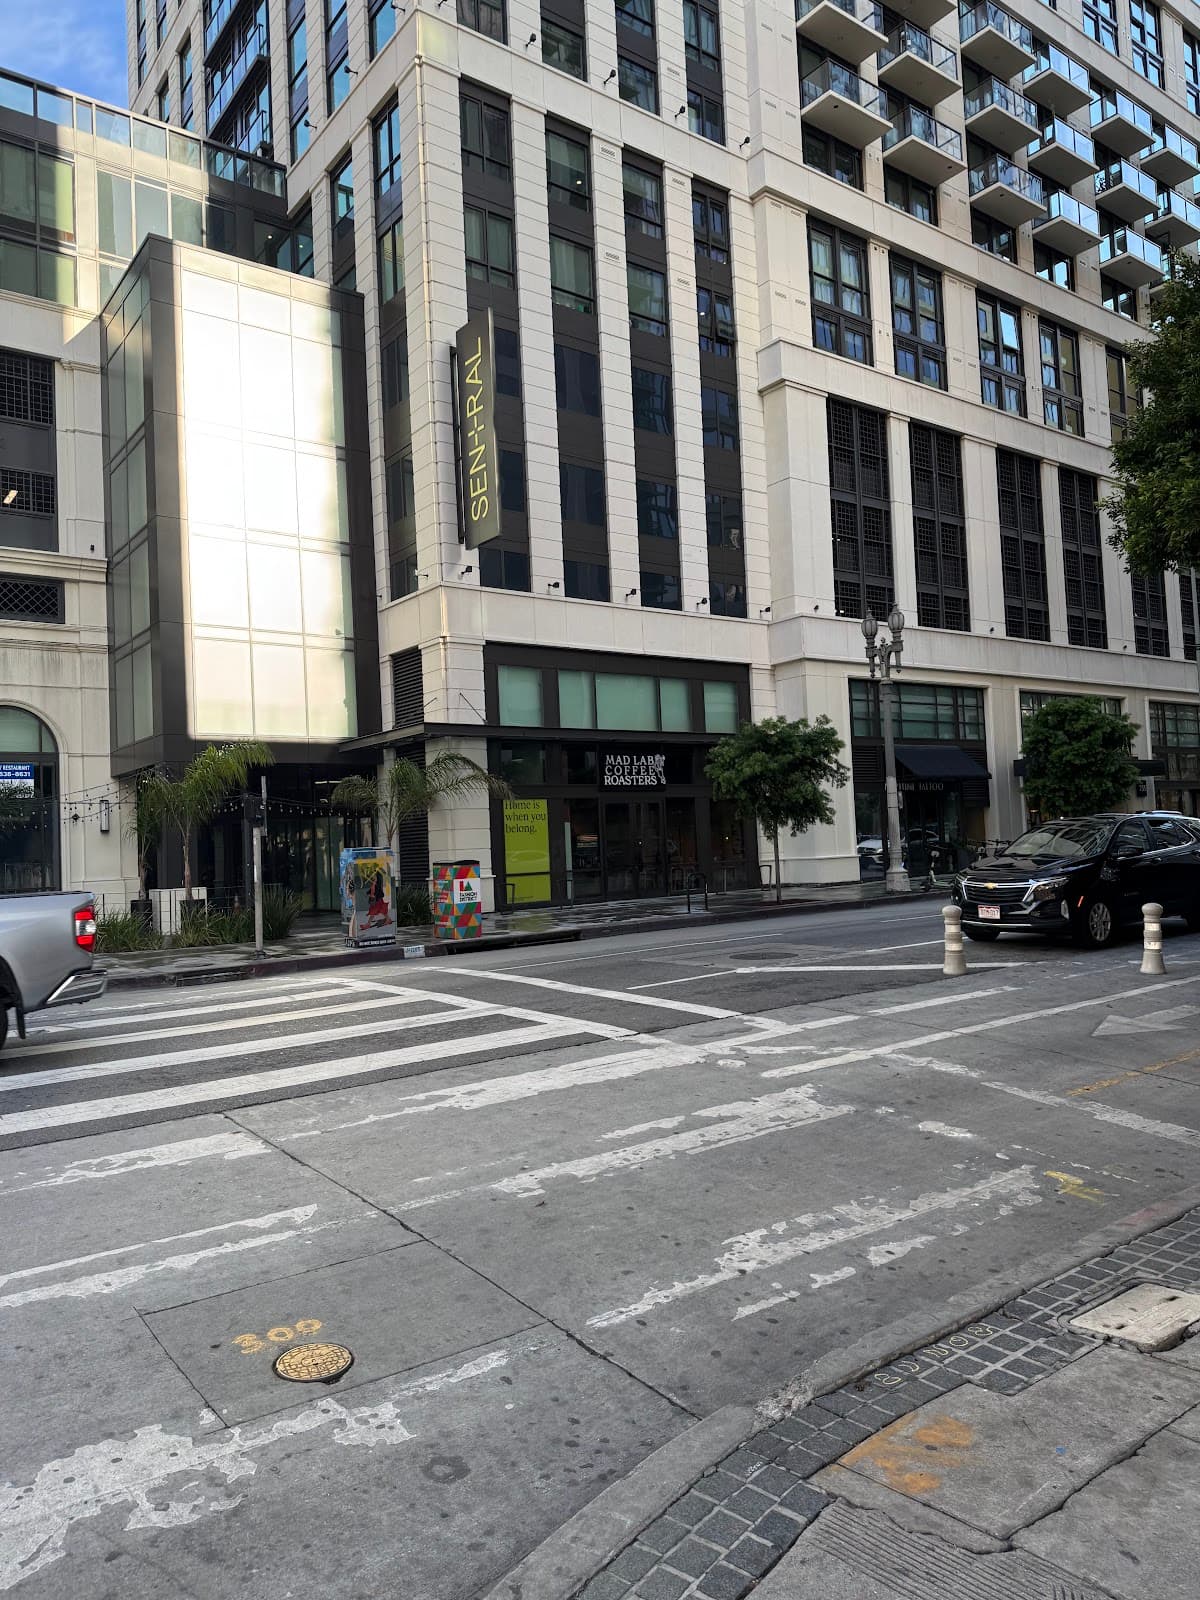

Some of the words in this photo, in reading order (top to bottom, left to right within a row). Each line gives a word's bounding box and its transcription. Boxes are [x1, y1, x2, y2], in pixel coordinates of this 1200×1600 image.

[605, 754, 631, 766] MAD
[633, 755, 655, 766] LAB
[604, 765, 656, 776] COFFEE
[604, 775, 658, 786] ROASTERS
[504, 800, 531, 810] Home
[533, 800, 541, 810] is
[504, 812, 529, 822] when
[530, 812, 546, 823] you
[505, 823, 538, 835] belong.
[459, 880, 473, 891] LA
